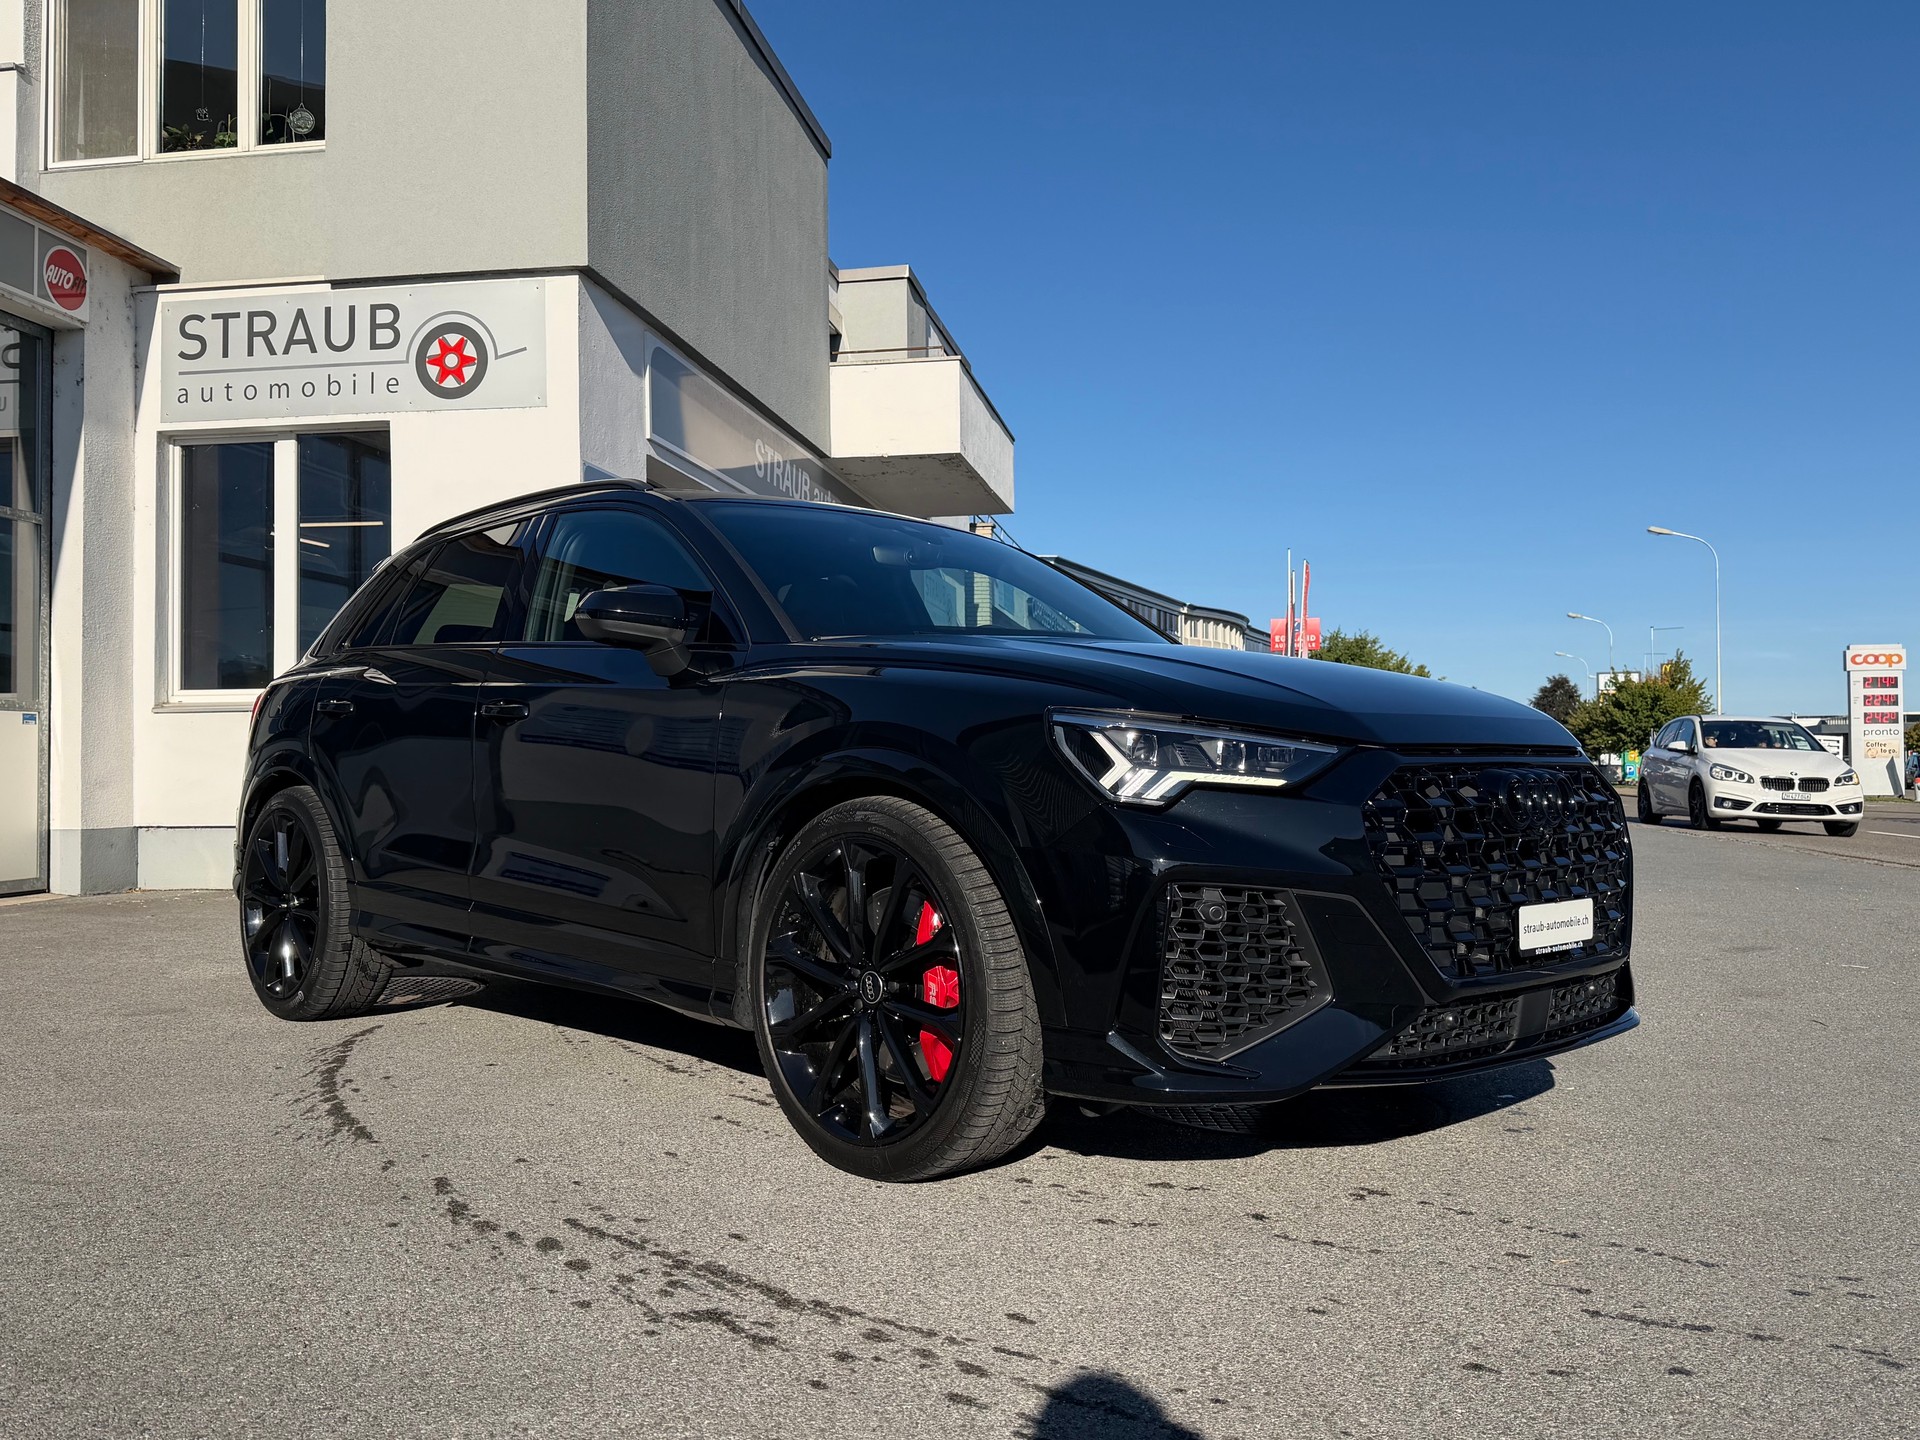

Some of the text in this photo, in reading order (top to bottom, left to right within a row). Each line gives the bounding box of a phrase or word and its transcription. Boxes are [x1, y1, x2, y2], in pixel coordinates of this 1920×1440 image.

[178, 303, 401, 361] STRAUB
[177, 372, 399, 404] automobile
[755, 438, 810, 501] STRAUB
[1850, 653, 1903, 668] coop
[1863, 728, 1900, 737] pronto
[1626, 765, 1634, 775] P
[1523, 914, 1589, 935] straub-automobile.ch
[1535, 940, 1584, 955] straub-automobile.ch
